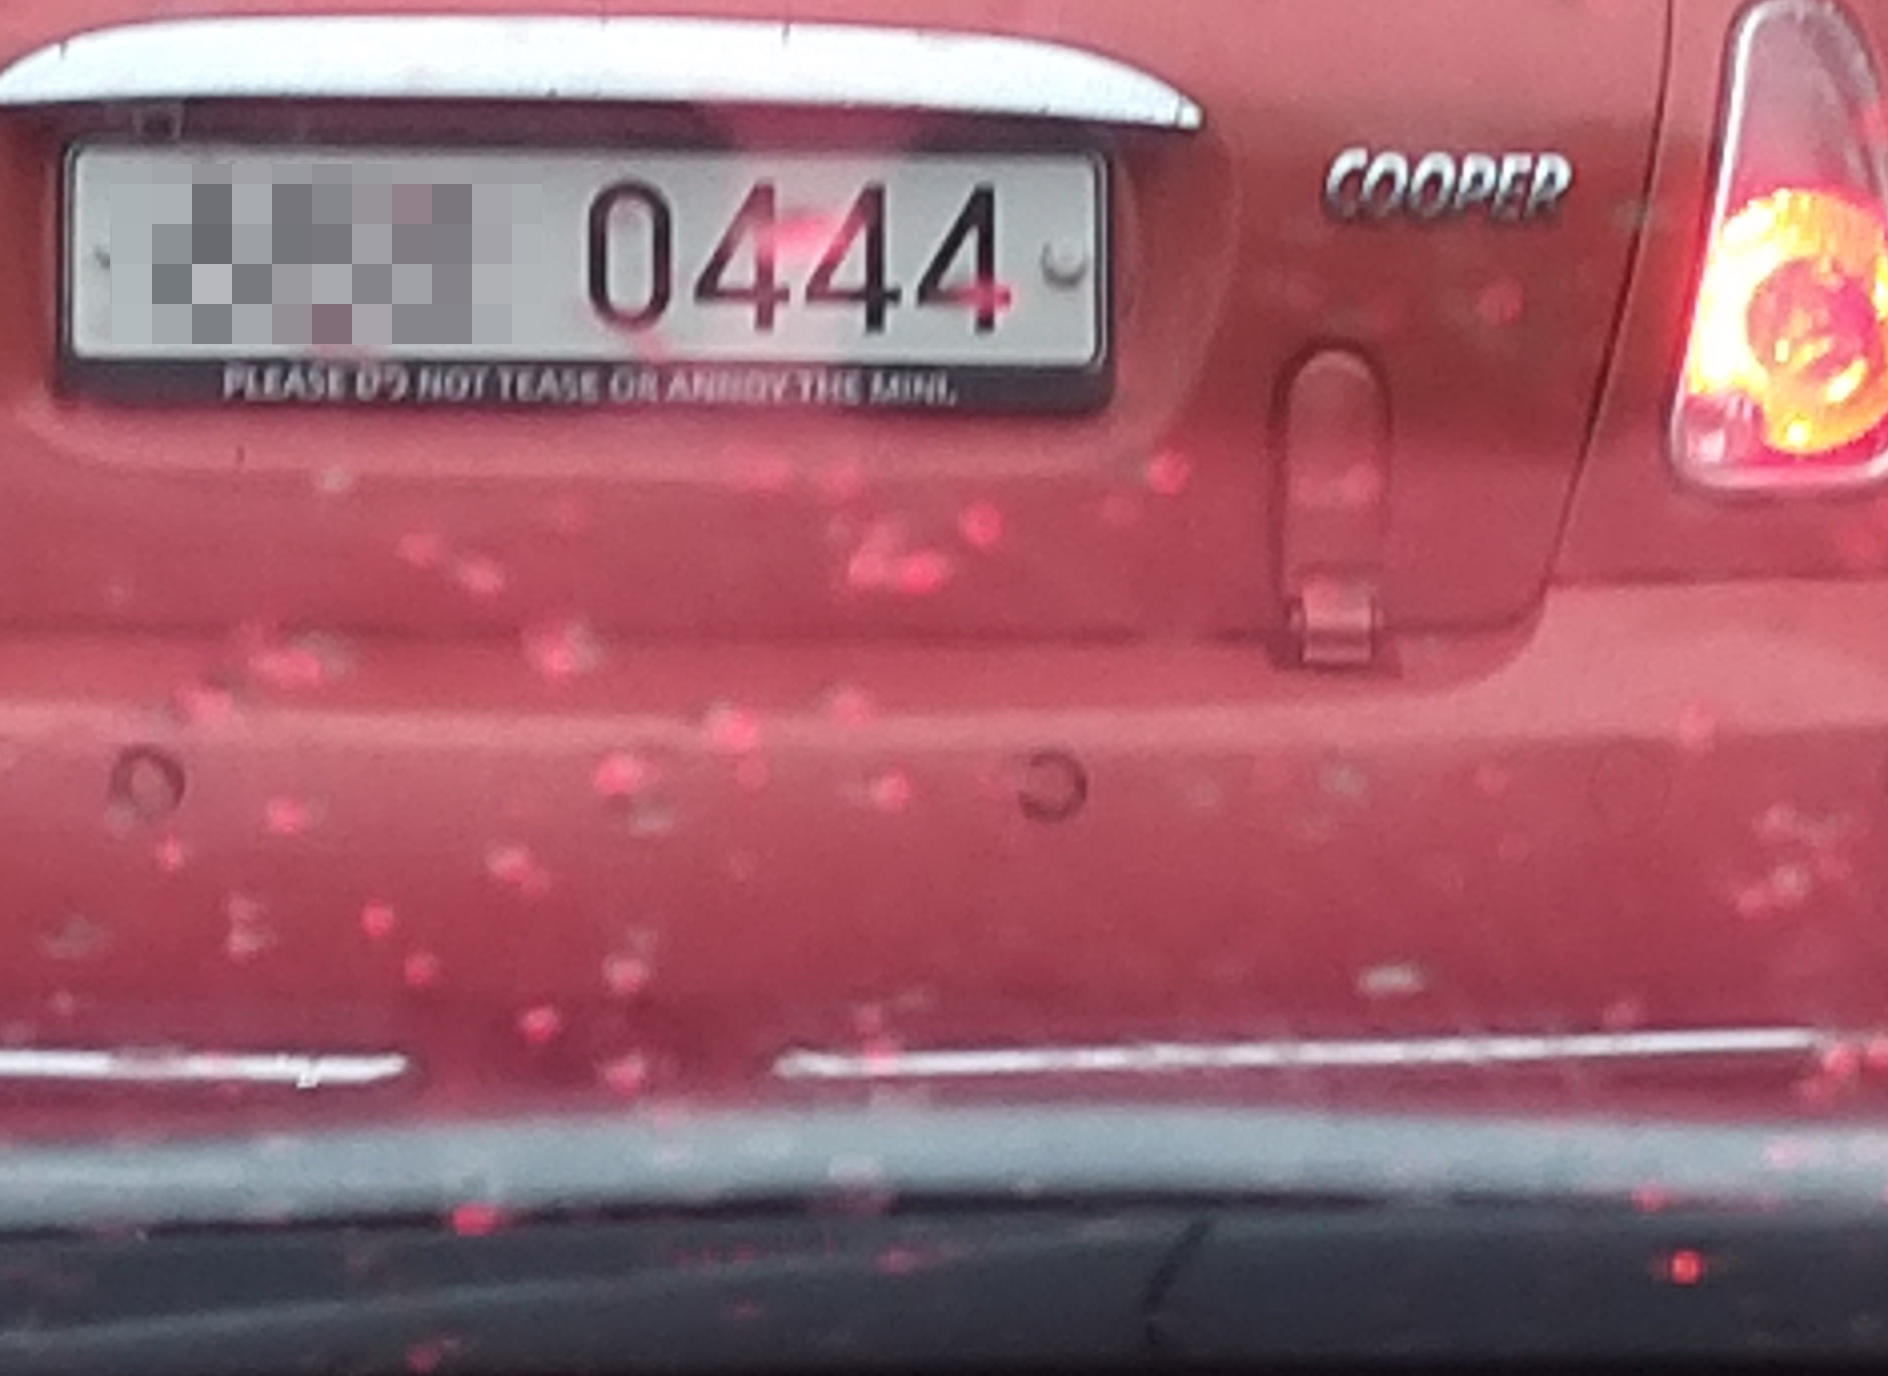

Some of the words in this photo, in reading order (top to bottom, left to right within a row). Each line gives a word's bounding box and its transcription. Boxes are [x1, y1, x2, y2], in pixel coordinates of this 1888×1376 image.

[1324, 146, 1573, 220] COOPER
[586, 181, 1012, 334] 0444
[223, 364, 345, 401] PLEASE
[356, 366, 410, 402] DO
[417, 366, 488, 402] NOT
[497, 368, 601, 403] TEASE
[610, 368, 658, 402] OR
[666, 369, 792, 404] ANNOY
[796, 369, 863, 405] THE
